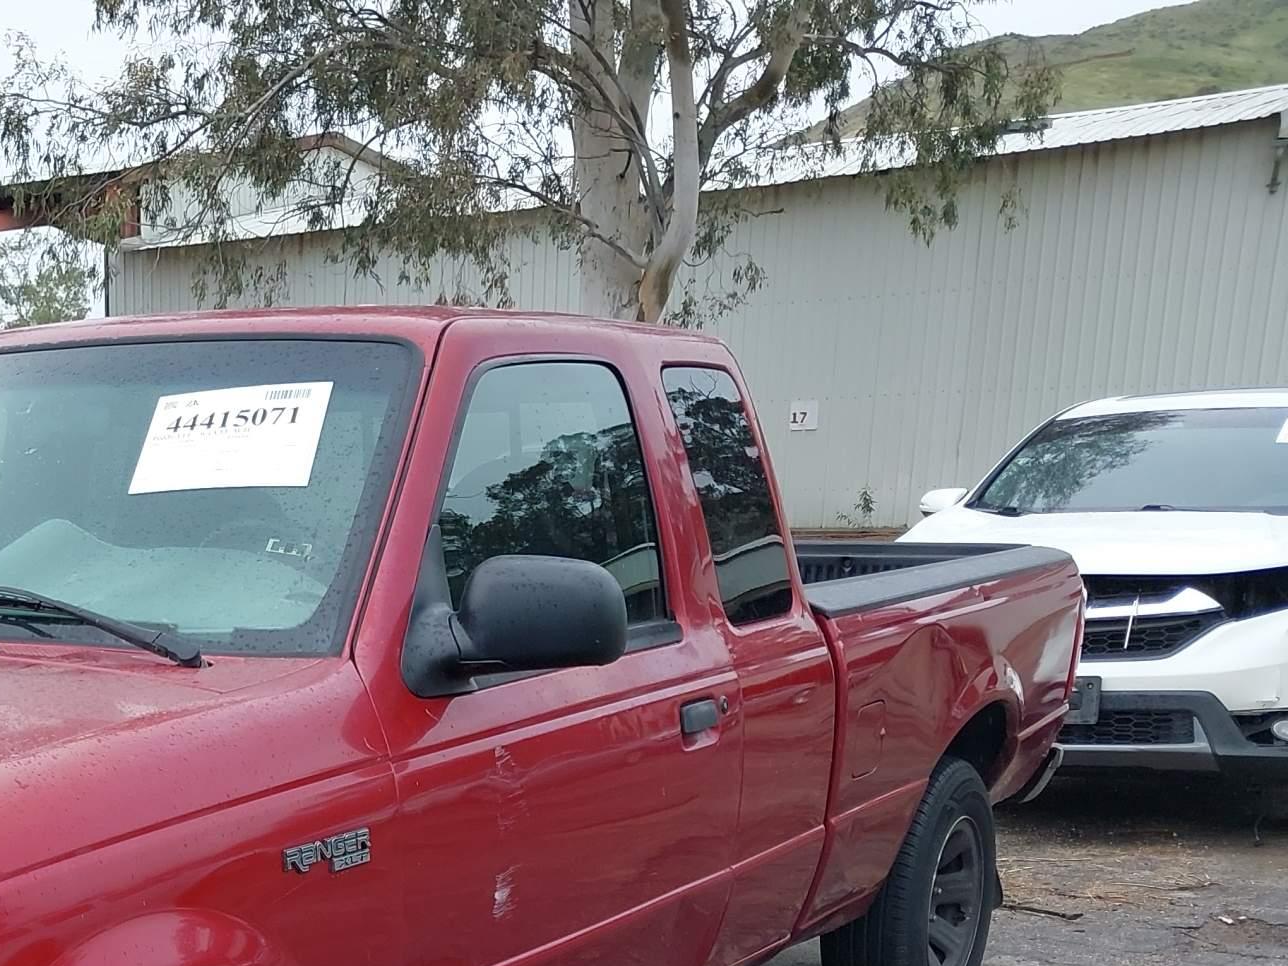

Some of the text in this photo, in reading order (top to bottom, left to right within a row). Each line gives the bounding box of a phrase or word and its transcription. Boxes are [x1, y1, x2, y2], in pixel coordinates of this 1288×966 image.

[166, 406, 300, 433] 44415071
[791, 411, 808, 424] 17
[283, 828, 371, 872] RANGER
